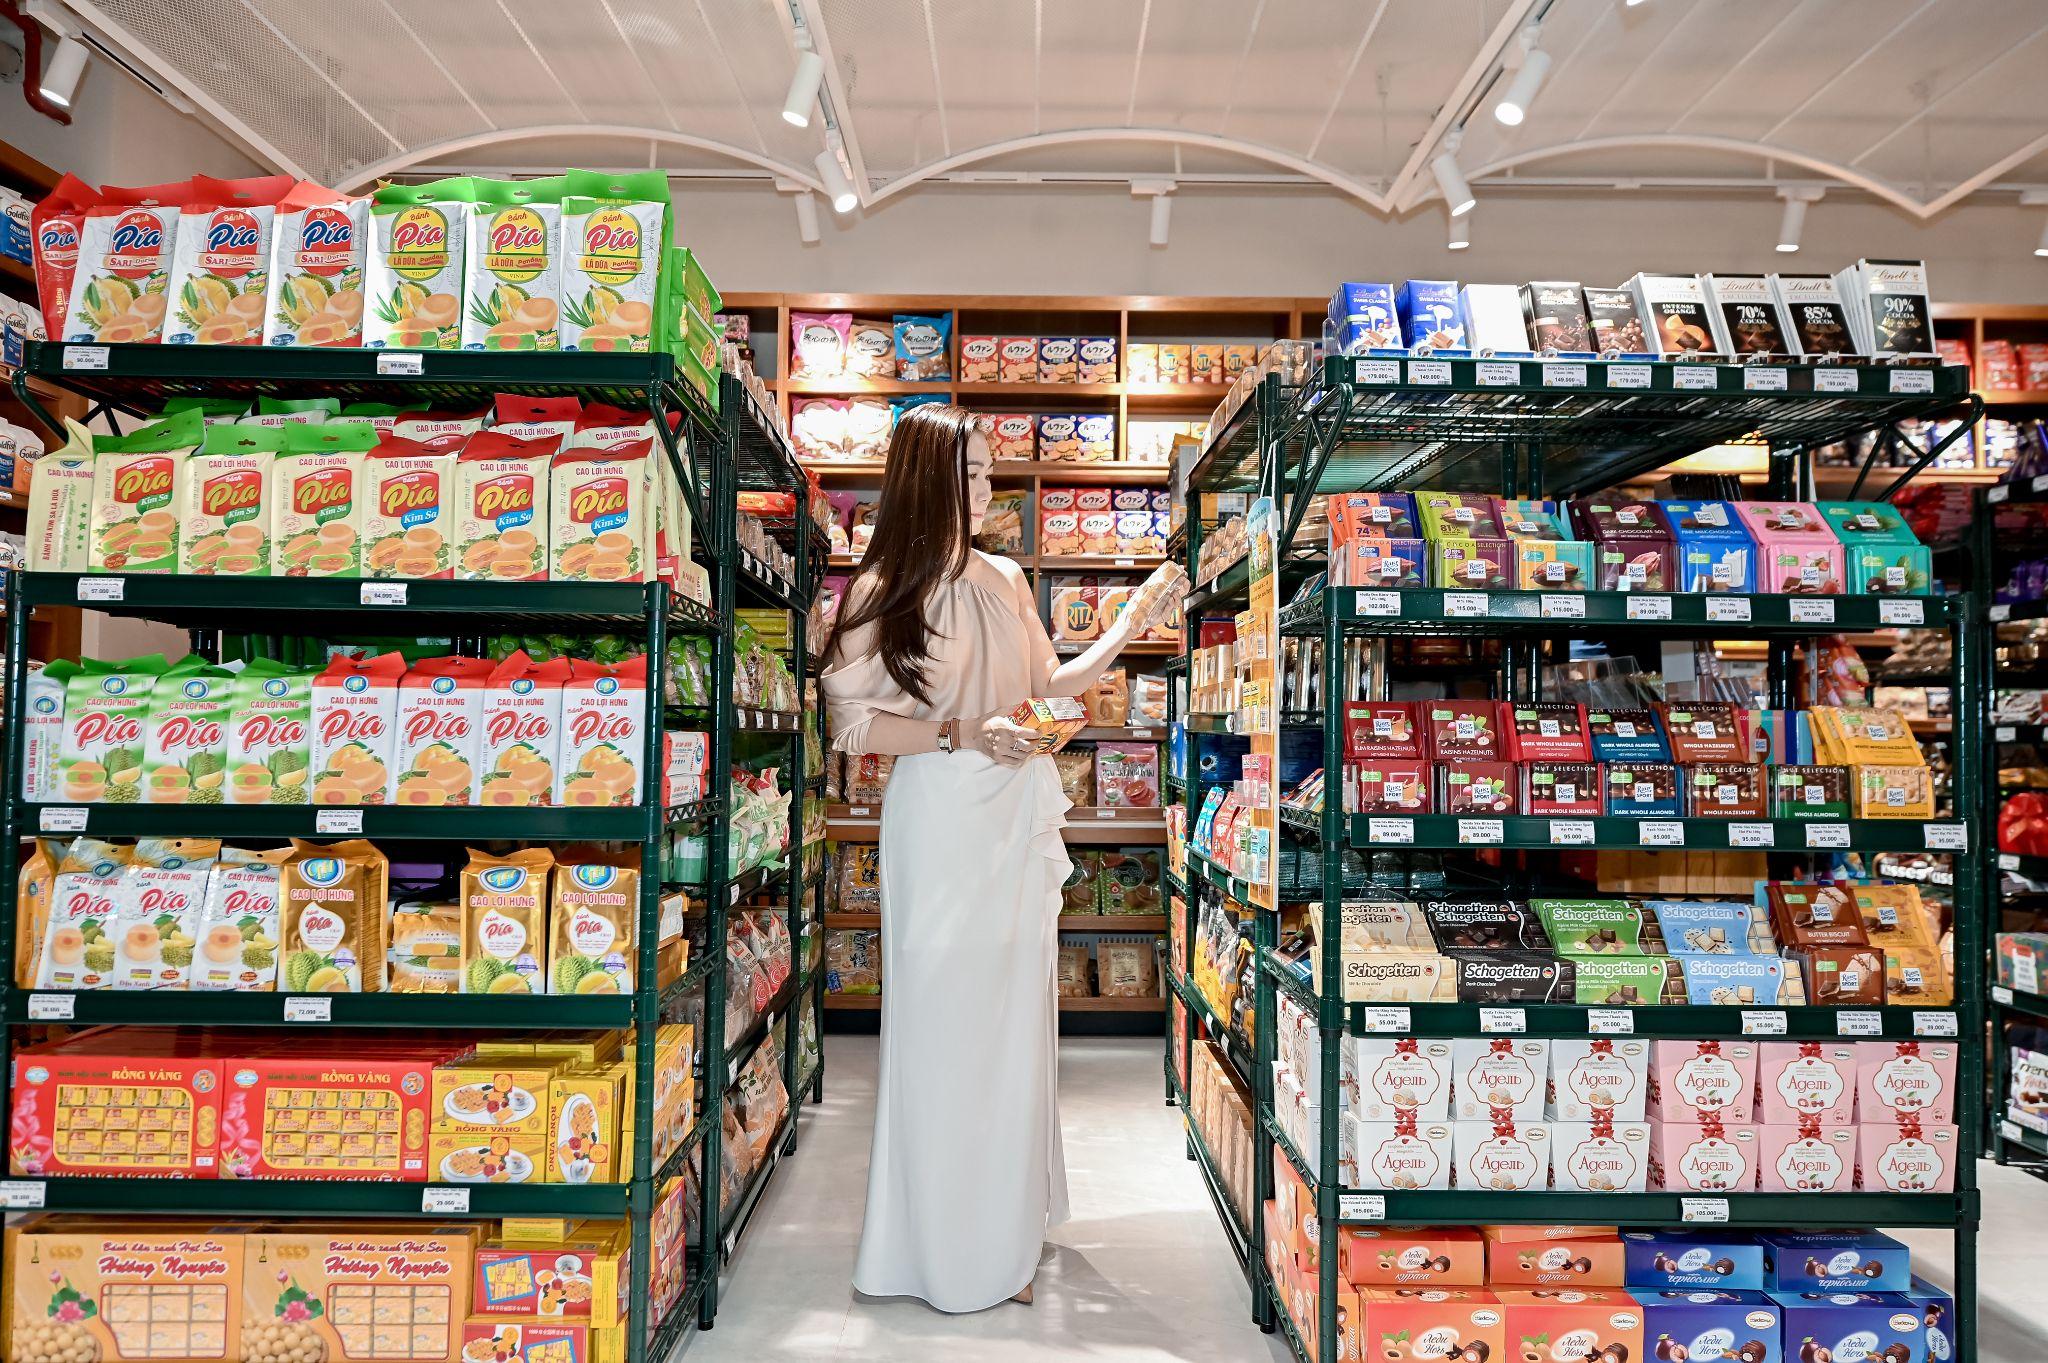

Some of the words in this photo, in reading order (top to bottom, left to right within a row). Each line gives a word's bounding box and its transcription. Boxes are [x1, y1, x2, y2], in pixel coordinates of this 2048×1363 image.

[410, 210, 430, 221] Bánh
[507, 211, 528, 223] Bánh
[601, 213, 623, 224] Bánh
[113, 222, 163, 252] Pía
[207, 222, 259, 250] Pía
[302, 219, 353, 249] Pía
[393, 221, 445, 252] Pía
[490, 222, 543, 252] Pía
[585, 223, 638, 254] Pía
[109, 256, 132, 267] SARI
[204, 255, 229, 267] SARI
[300, 253, 324, 265] SARI
[393, 254, 402, 265] LÁ
[419, 254, 445, 263] Pandan
[490, 256, 500, 268] LÁ
[517, 256, 543, 265] Pandan
[1736, 305, 1766, 319] 70%
[1803, 306, 1833, 320] 85%
[1884, 297, 1915, 312] 90%
[208, 460, 222, 469] CAO
[298, 458, 312, 466] CAO
[384, 460, 399, 469] CAO
[480, 463, 494, 472] CAO
[575, 467, 589, 476] CAO
[117, 468, 170, 503] Pía
[141, 495, 157, 507] Kim
[157, 494, 169, 504] Sa
[205, 483, 259, 513] Pía
[297, 479, 349, 511] Pía
[383, 482, 437, 515] Pía
[477, 485, 531, 518] Pía
[319, 506, 335, 518] Kim
[336, 505, 347, 515] Sa
[573, 489, 625, 521] Pía
[403, 512, 423, 524] Kim
[425, 510, 437, 521] Sa
[1067, 605, 1093, 625] RITZ
[330, 696, 345, 704] CAO
[74, 712, 142, 750] Pía
[157, 715, 224, 753] Pía
[238, 714, 307, 752] Pía
[319, 709, 387, 747] Pía
[405, 709, 472, 747] Pía
[485, 710, 552, 748] Pía
[570, 709, 636, 748] Pía
[1435, 911, 1506, 923] Schogetten
[1553, 908, 1624, 923] Schogetten
[1662, 905, 1734, 921] Schogetten
[1347, 961, 1421, 980] Schogetten
[1465, 963, 1540, 979] Schogetten
[1576, 962, 1647, 978] Schogetten
[1690, 960, 1765, 978] Schogetten
[1382, 1073, 1427, 1090] Адель
[1478, 1071, 1522, 1088] Адель
[1578, 1072, 1623, 1089] Адель
[1684, 1072, 1730, 1090] Адель
[1786, 1074, 1832, 1092] Адель
[1883, 1073, 1930, 1090] Адель
[1382, 1155, 1426, 1172] Адель
[1480, 1154, 1525, 1171] Адель
[1578, 1155, 1623, 1172] Адель
